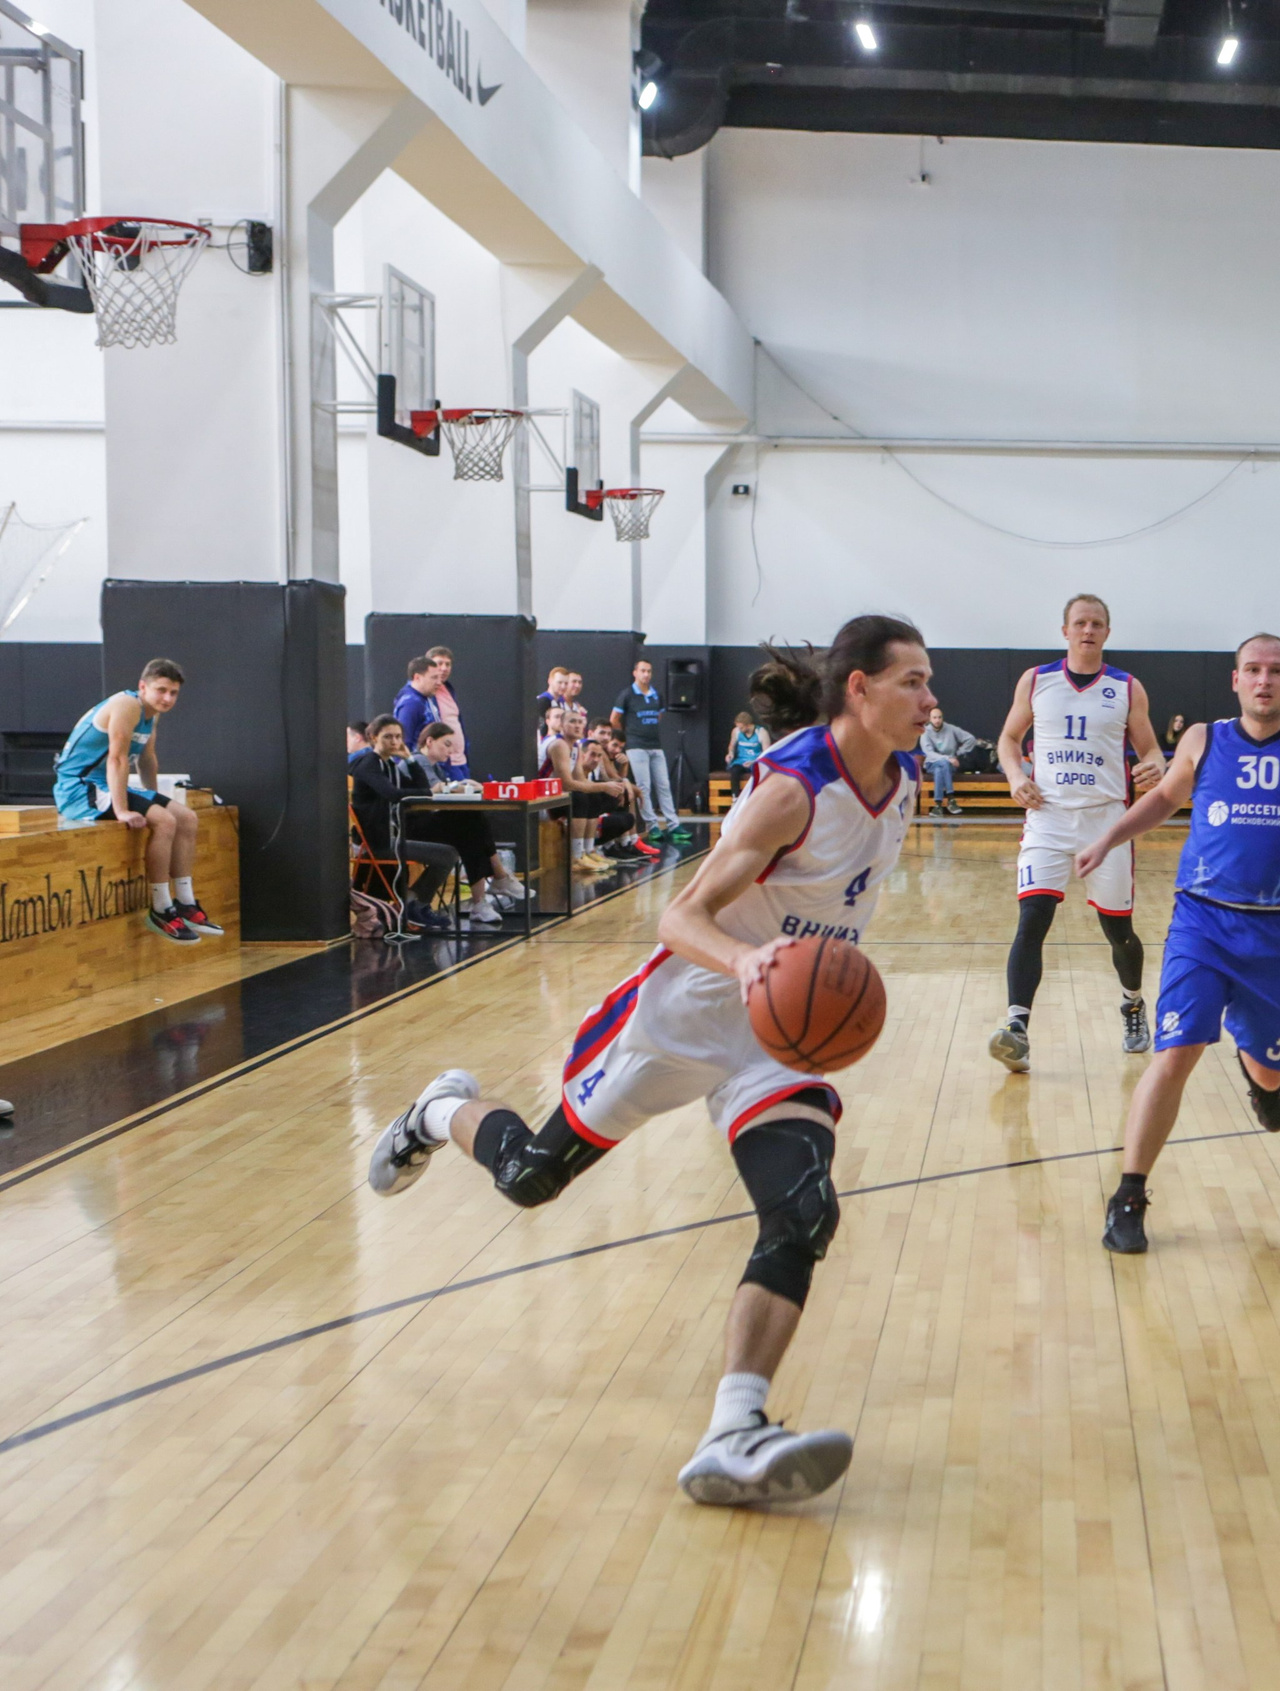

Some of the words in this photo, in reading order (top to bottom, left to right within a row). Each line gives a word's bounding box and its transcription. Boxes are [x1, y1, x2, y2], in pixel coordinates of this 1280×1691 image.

[1063, 714, 1088, 741] 11
[1047, 750, 1105, 767] ВНИИЭФ
[1056, 772, 1096, 786] САРОВ
[1235, 755, 1280, 790] 30
[844, 866, 872, 907] 4
[1019, 864, 1035, 888] 11
[577, 1068, 606, 1107] 4
